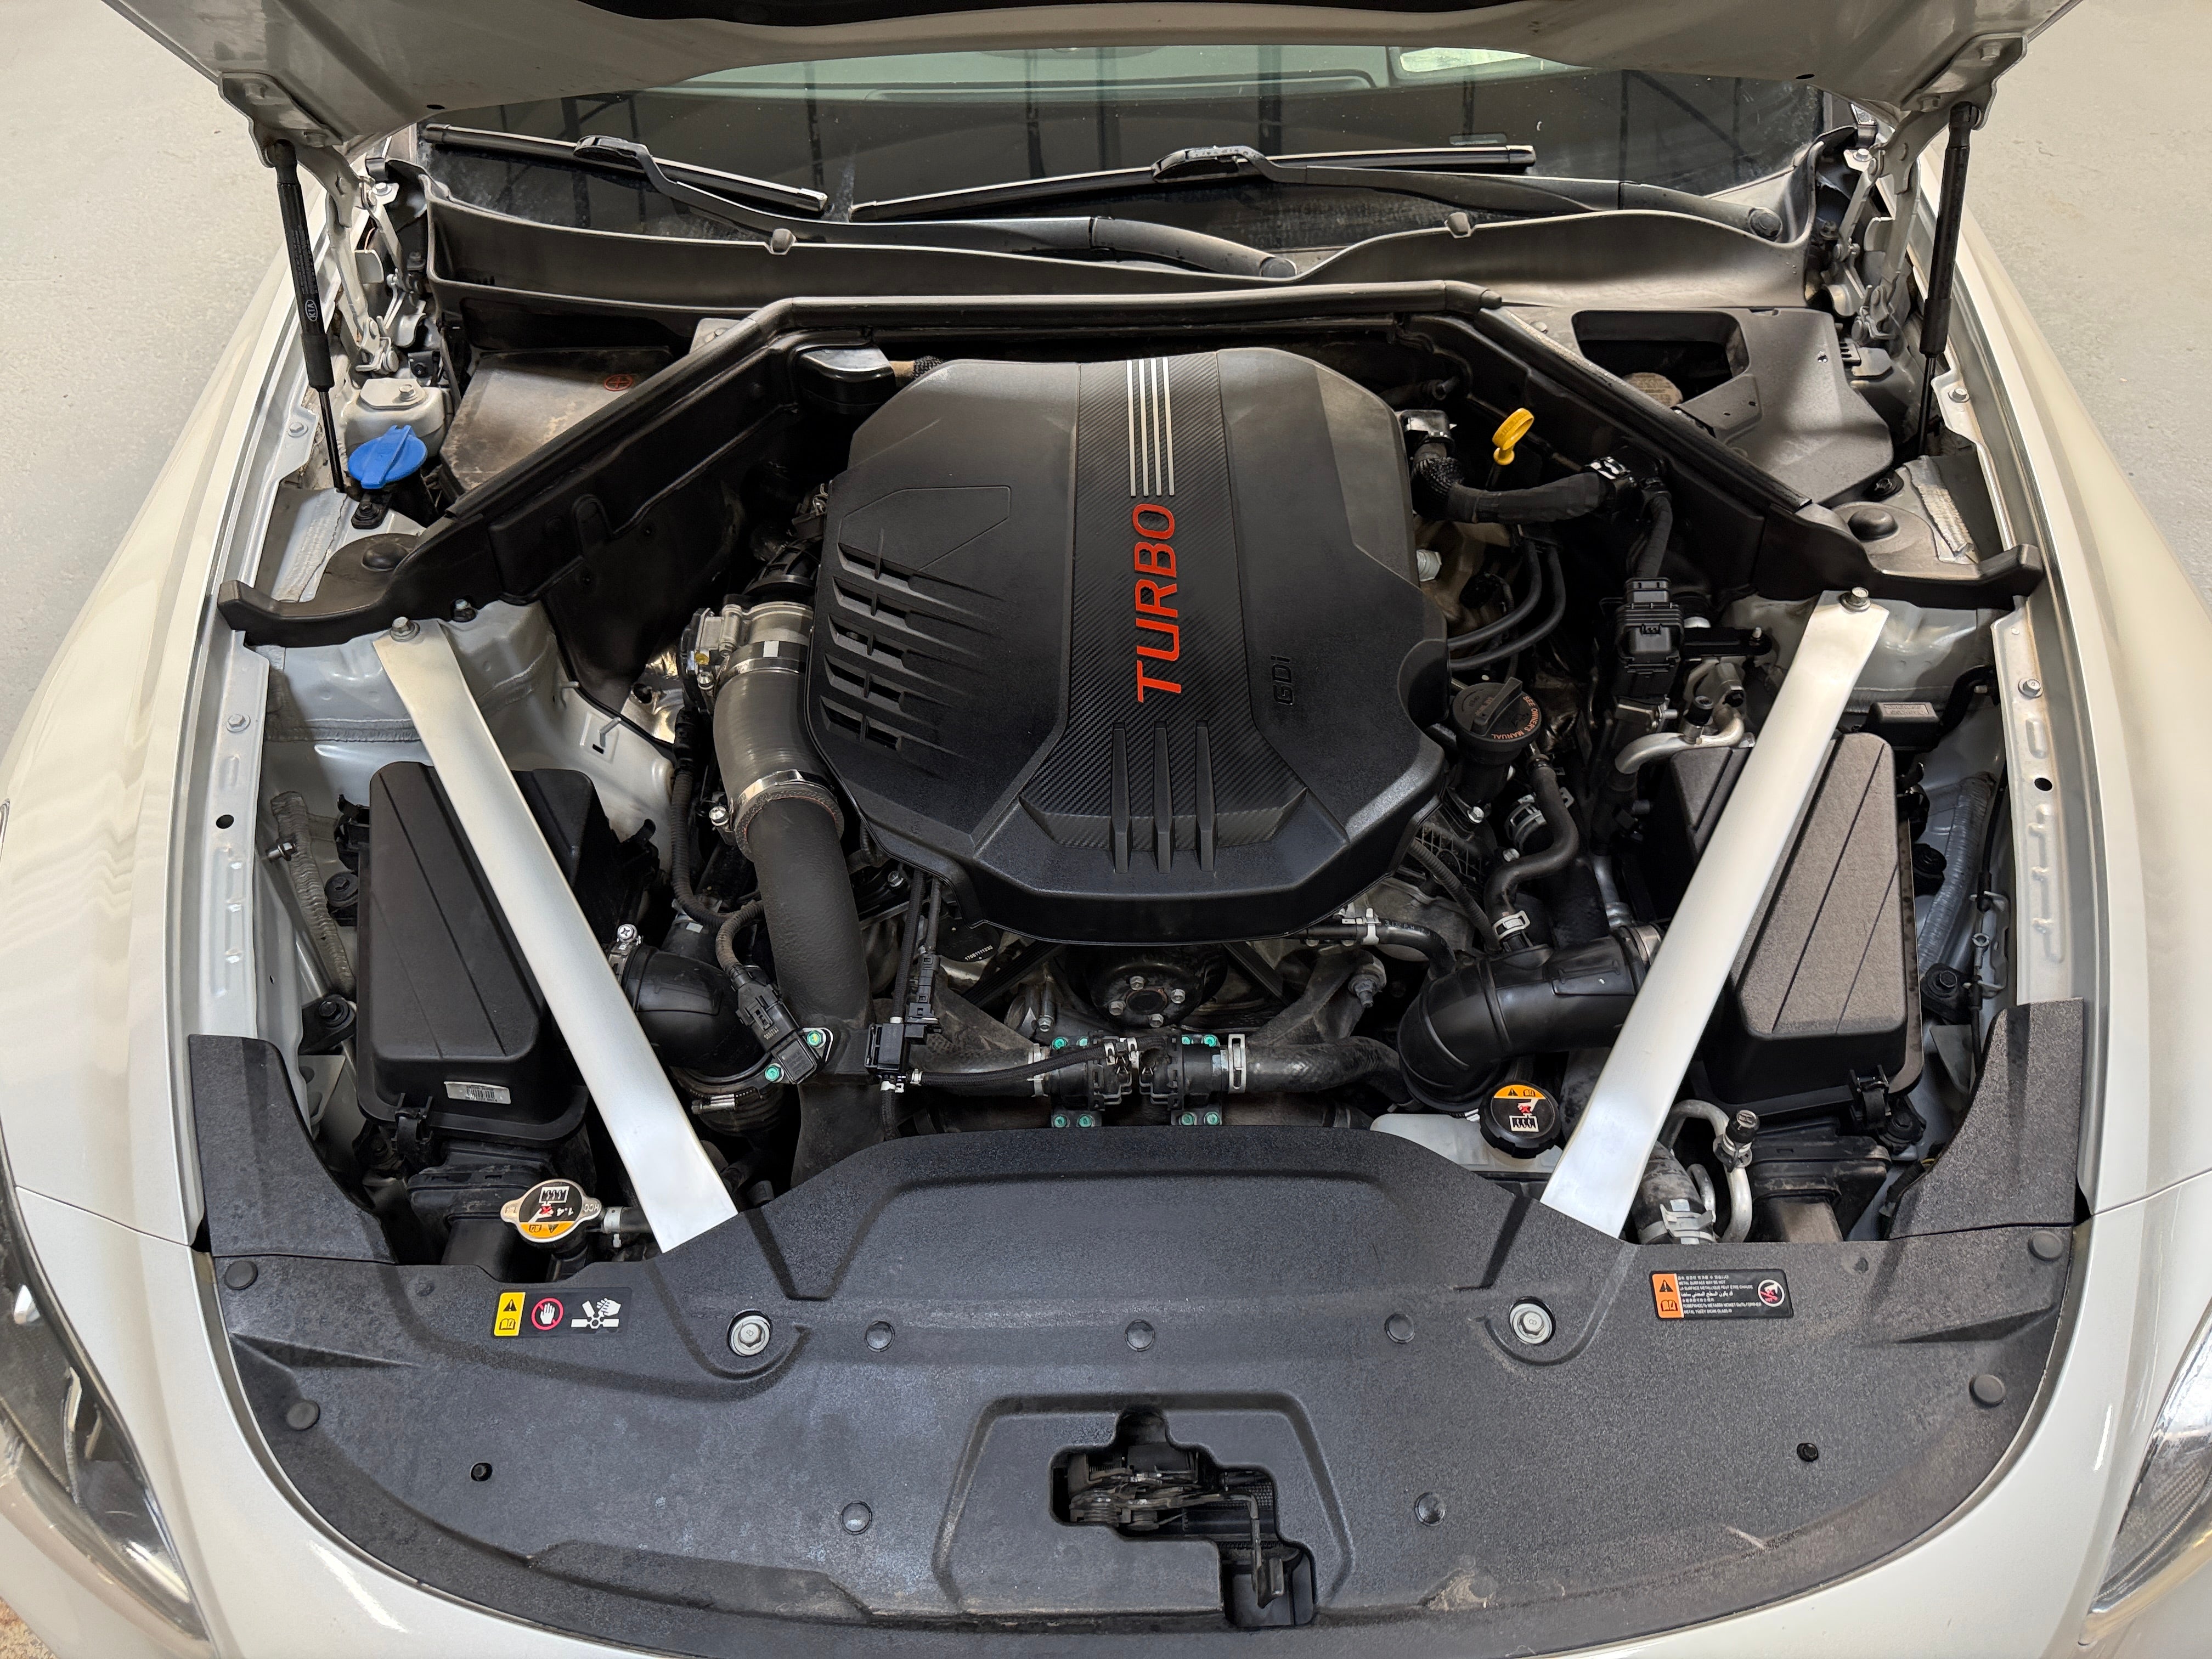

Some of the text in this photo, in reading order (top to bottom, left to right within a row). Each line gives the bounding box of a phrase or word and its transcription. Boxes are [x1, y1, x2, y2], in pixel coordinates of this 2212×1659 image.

[306, 301, 317, 321] KIA
[1132, 503, 1182, 703] TURBO
[1271, 655, 1294, 705] GDi
[1491, 696, 1539, 740] SEE OWNER'S MANUAL
[556, 1207, 574, 1216] 1.4
[583, 1203, 599, 1212] HCC
